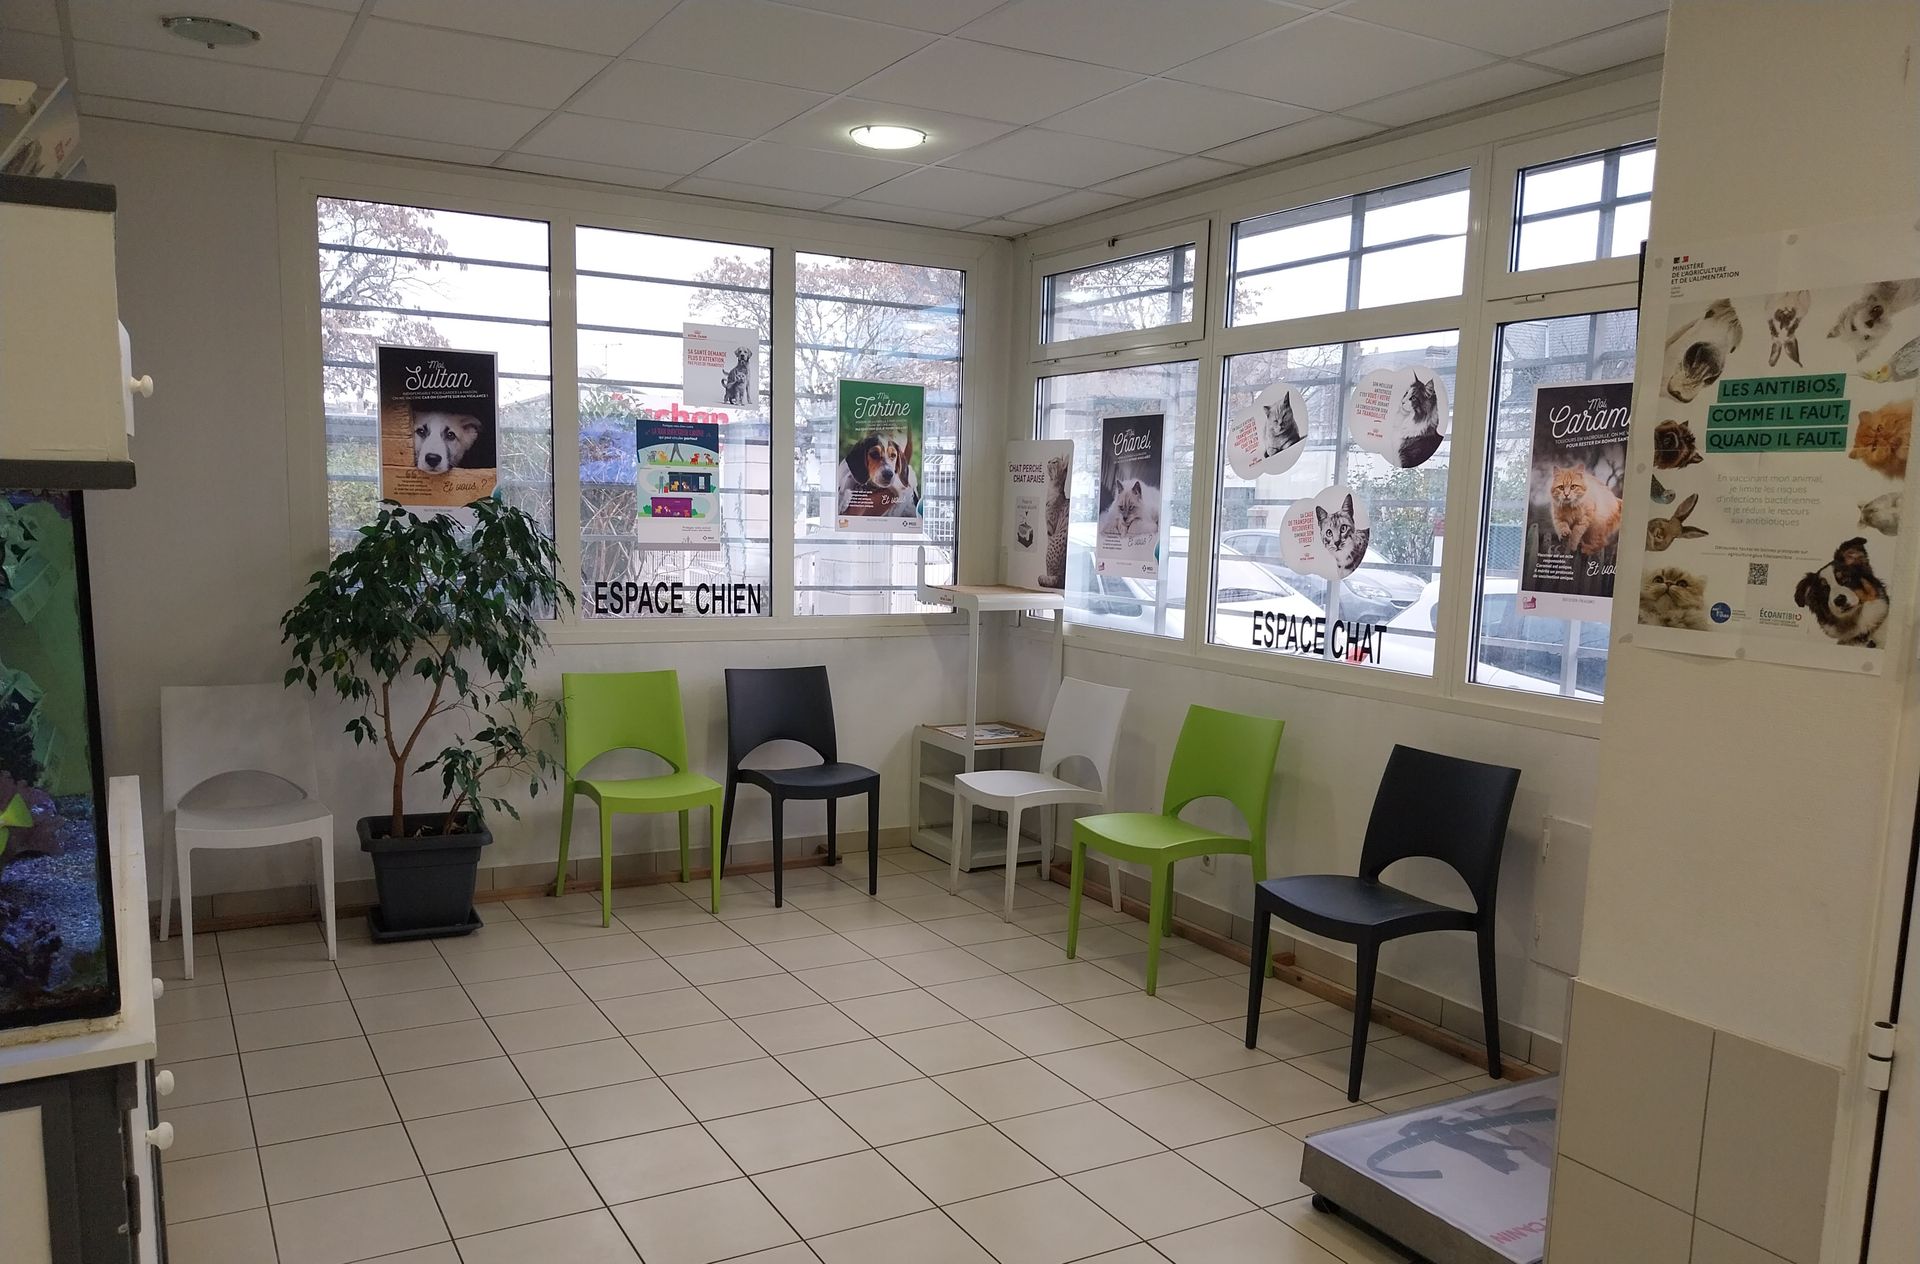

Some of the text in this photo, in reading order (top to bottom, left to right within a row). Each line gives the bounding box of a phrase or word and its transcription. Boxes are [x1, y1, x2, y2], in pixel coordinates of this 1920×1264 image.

[1681, 266, 1726, 276] L'AGRICULTURE
[1689, 271, 1740, 282] L'ALIMENTATION
[405, 366, 472, 390] Sultan
[1722, 378, 1840, 397] LES ANTIBIOS,
[854, 396, 911, 419] Tartine
[1587, 397, 1607, 411] Moi
[1549, 405, 1631, 438] Caram
[1712, 405, 1845, 422] COMME IL FAUT,
[1709, 432, 1842, 449] QUAND IL FAUT.
[1586, 560, 1599, 576] Et
[595, 581, 761, 614] ESPACE CHIEN
[1252, 610, 1387, 664] ESPACE CHAT
